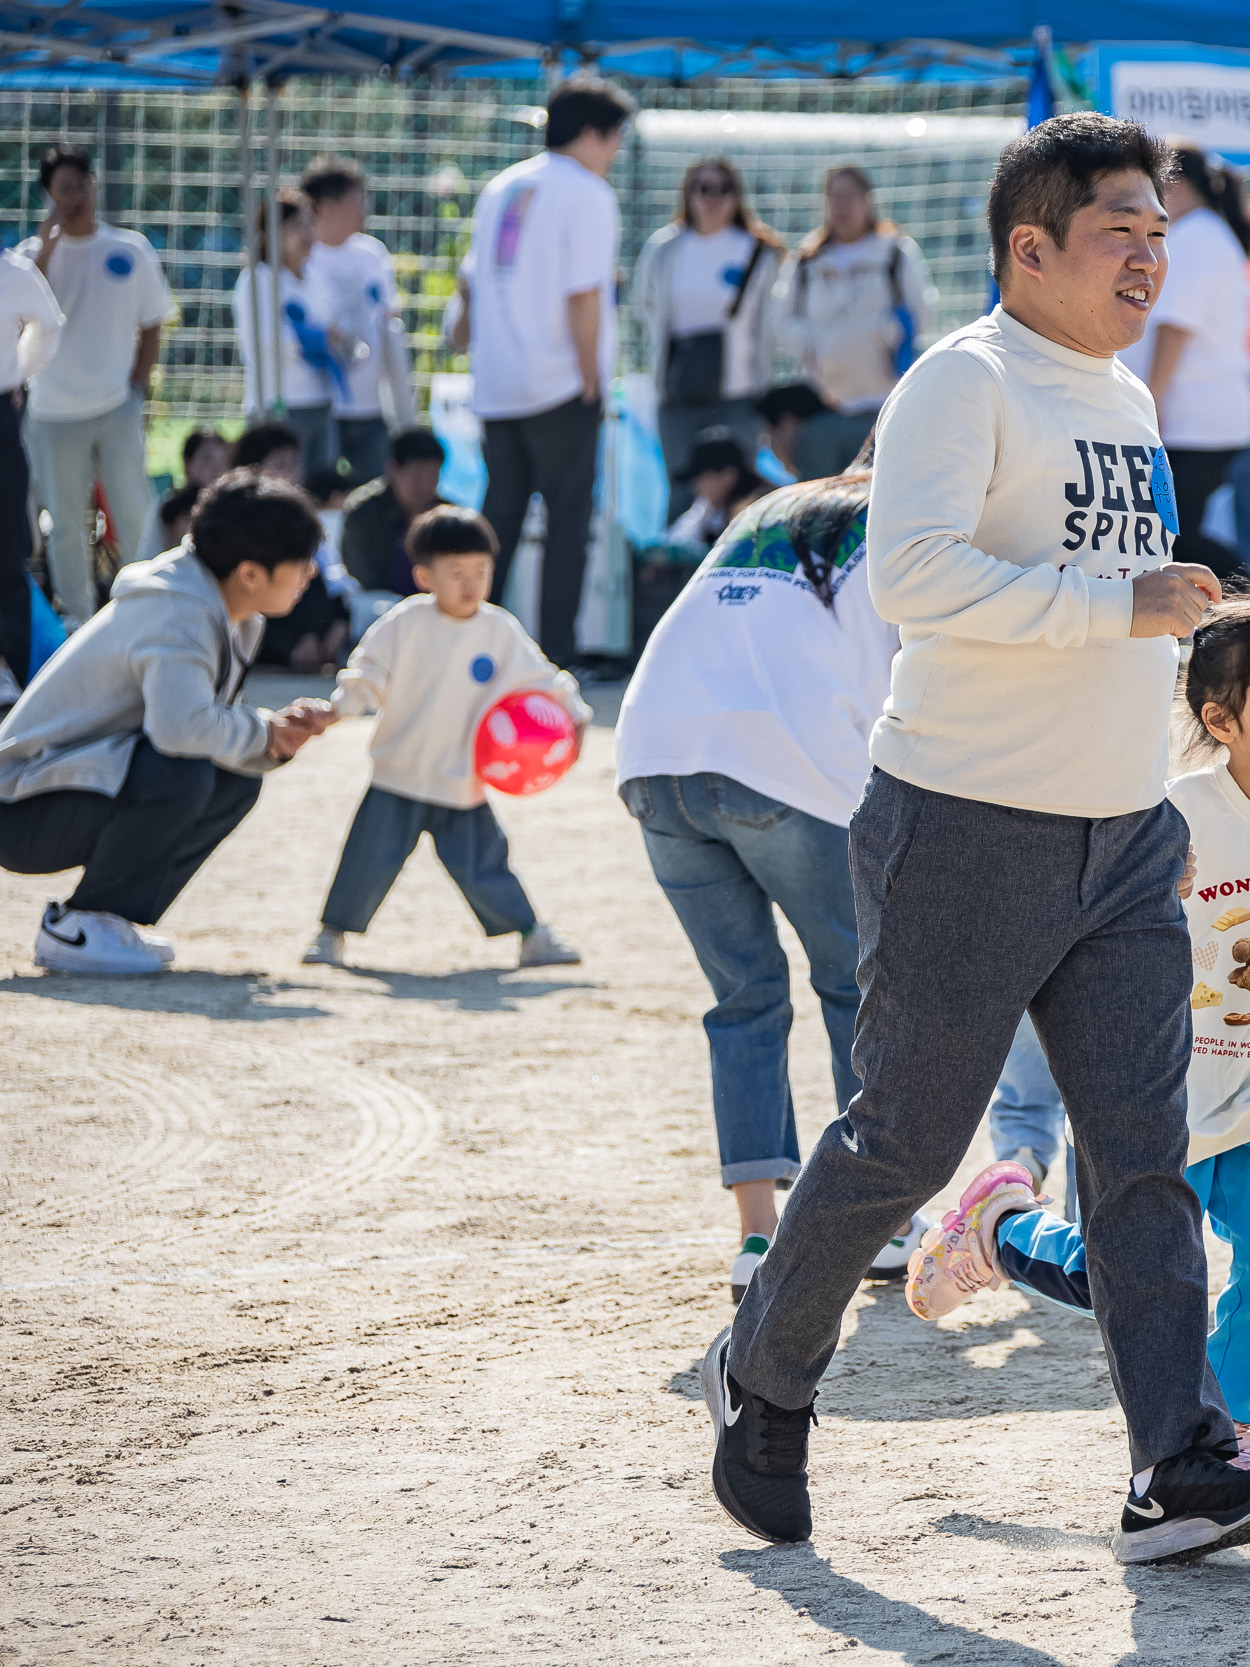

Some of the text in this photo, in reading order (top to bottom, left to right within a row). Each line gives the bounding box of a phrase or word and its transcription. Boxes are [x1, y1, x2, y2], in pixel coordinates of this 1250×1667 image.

[1065, 439, 1158, 513] JEE
[1062, 511, 1169, 557] SPIRI
[1192, 1046, 1208, 1055] VED
[1211, 1048, 1245, 1058] HAPPILY
[1194, 1036, 1225, 1047] PEOPLE
[1227, 1040, 1237, 1048] IN
